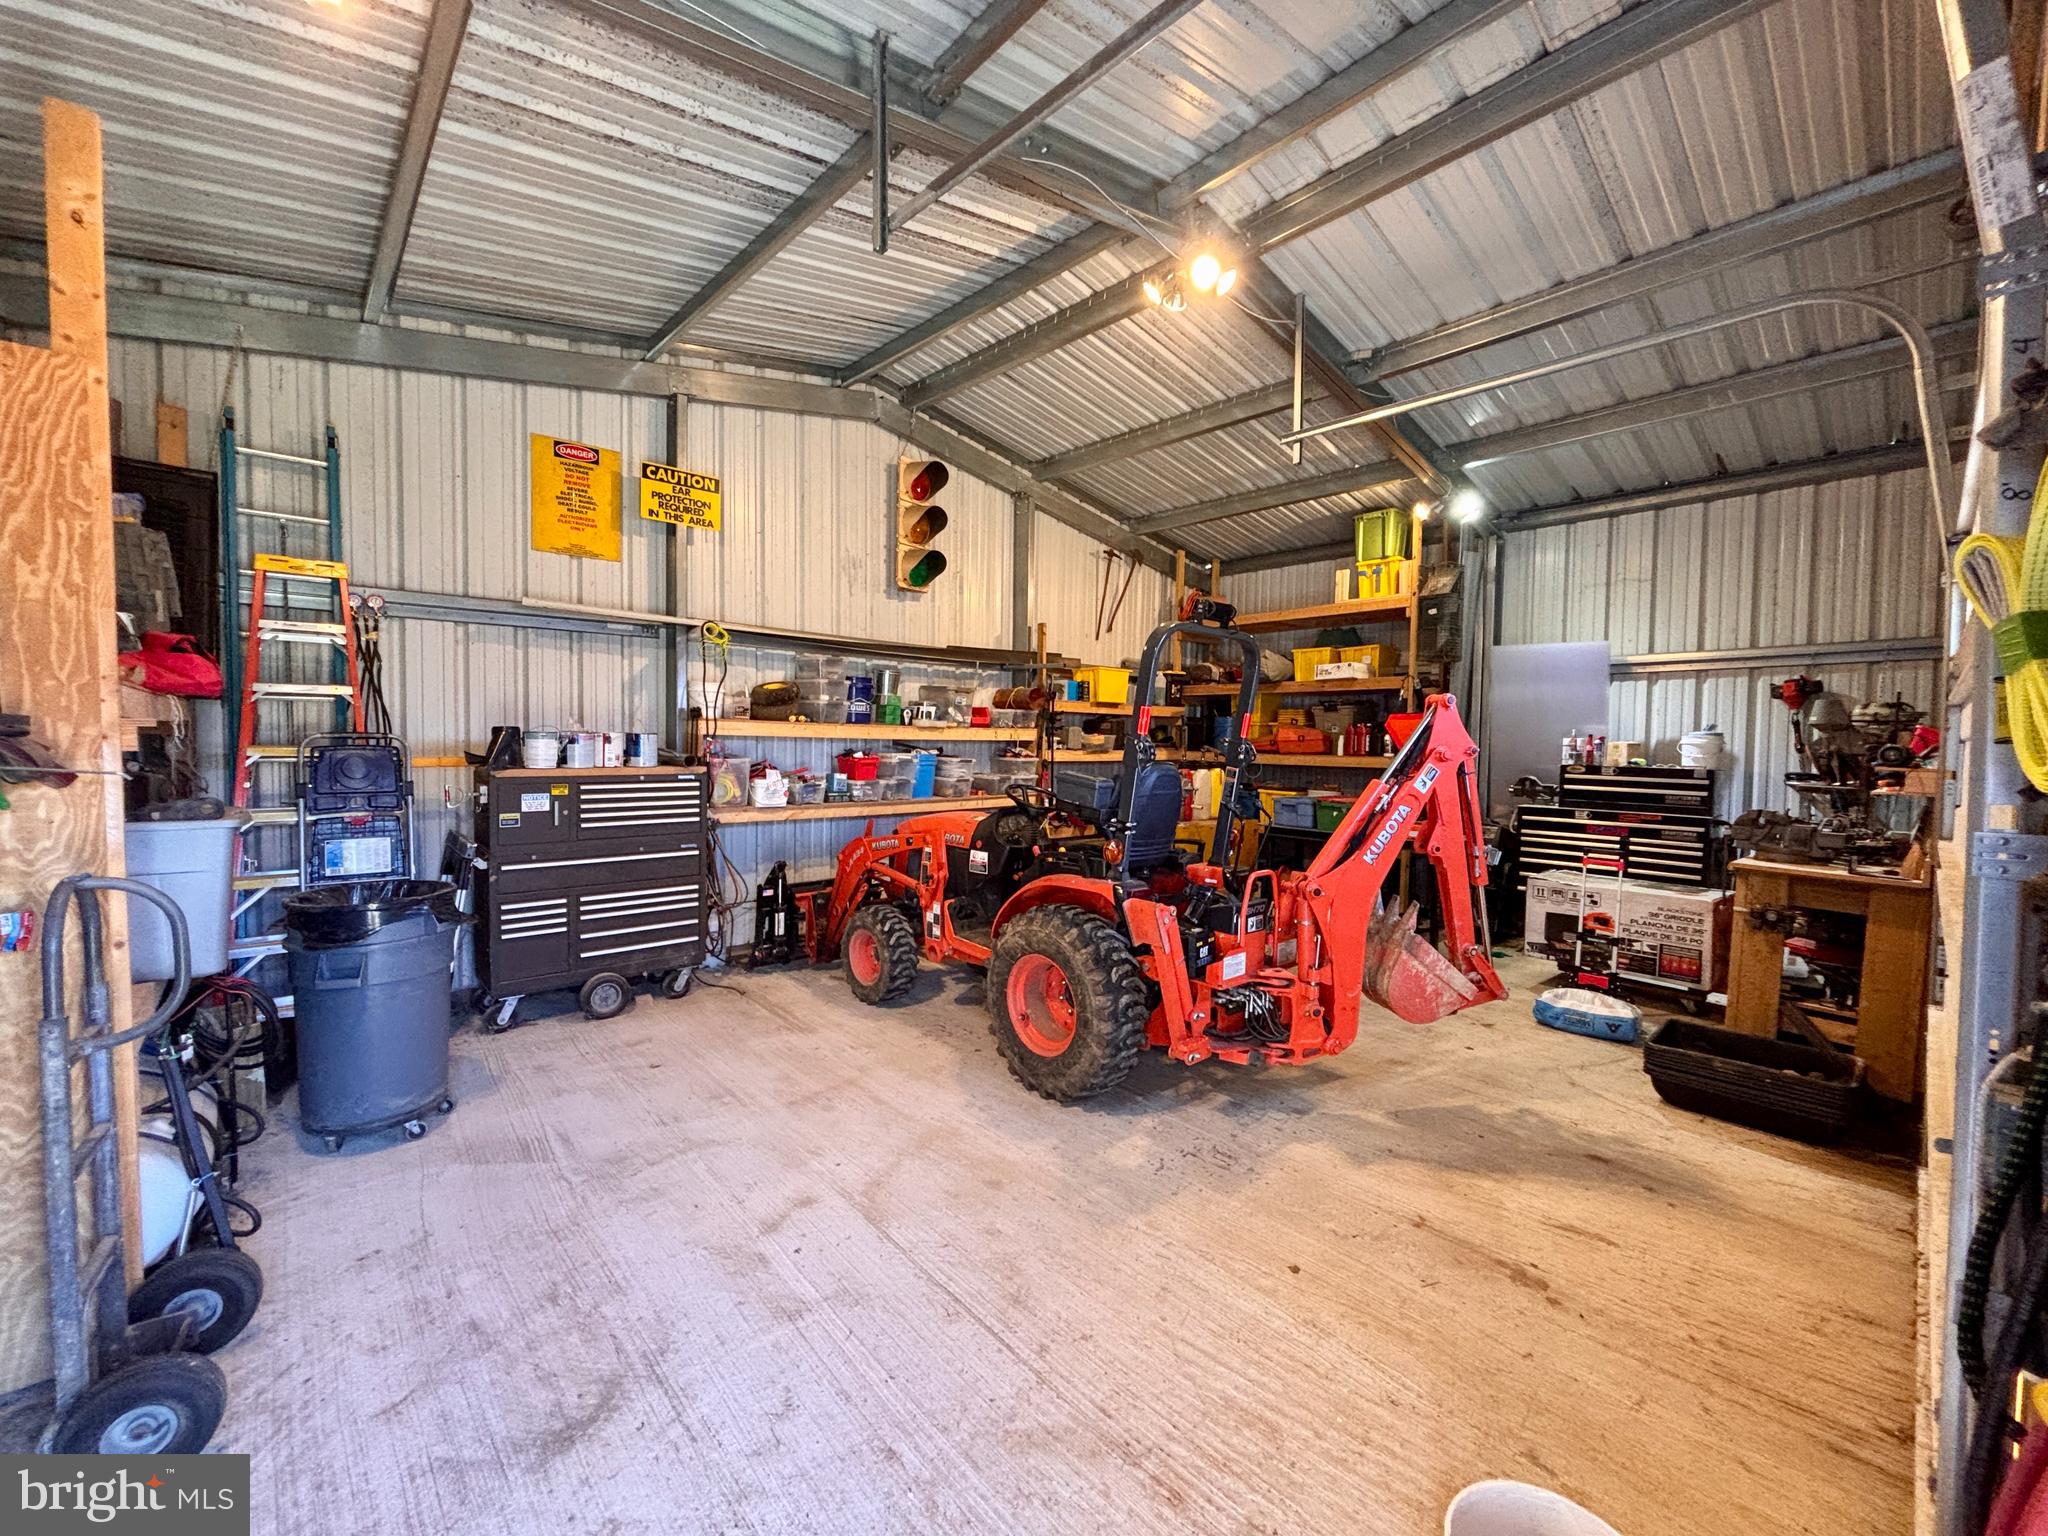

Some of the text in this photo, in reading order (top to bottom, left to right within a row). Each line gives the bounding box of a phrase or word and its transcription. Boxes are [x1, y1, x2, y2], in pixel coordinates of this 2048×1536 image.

[559, 446, 595, 460] DANGER
[563, 467, 590, 477] VOLTAGE
[576, 475, 590, 483] NOT
[646, 465, 716, 492] CAUTION
[563, 479, 591, 489] REMOVE
[566, 486, 589, 495] SEVERE
[672, 485, 691, 497] EAR
[651, 490, 712, 510] PROTECTION
[658, 500, 705, 517] REQUIRED
[648, 508, 714, 529] IN THIS AREA
[1362, 804, 1413, 866] KUBOTA
[871, 838, 900, 850] KUBOTA
[1630, 918, 1674, 930] PLANCHA
[1676, 925, 1690, 933] DE
[1663, 913, 1705, 925] GRIDDLE
[1622, 927, 1659, 938] PLAQUE
[1660, 933, 1674, 941] DE
